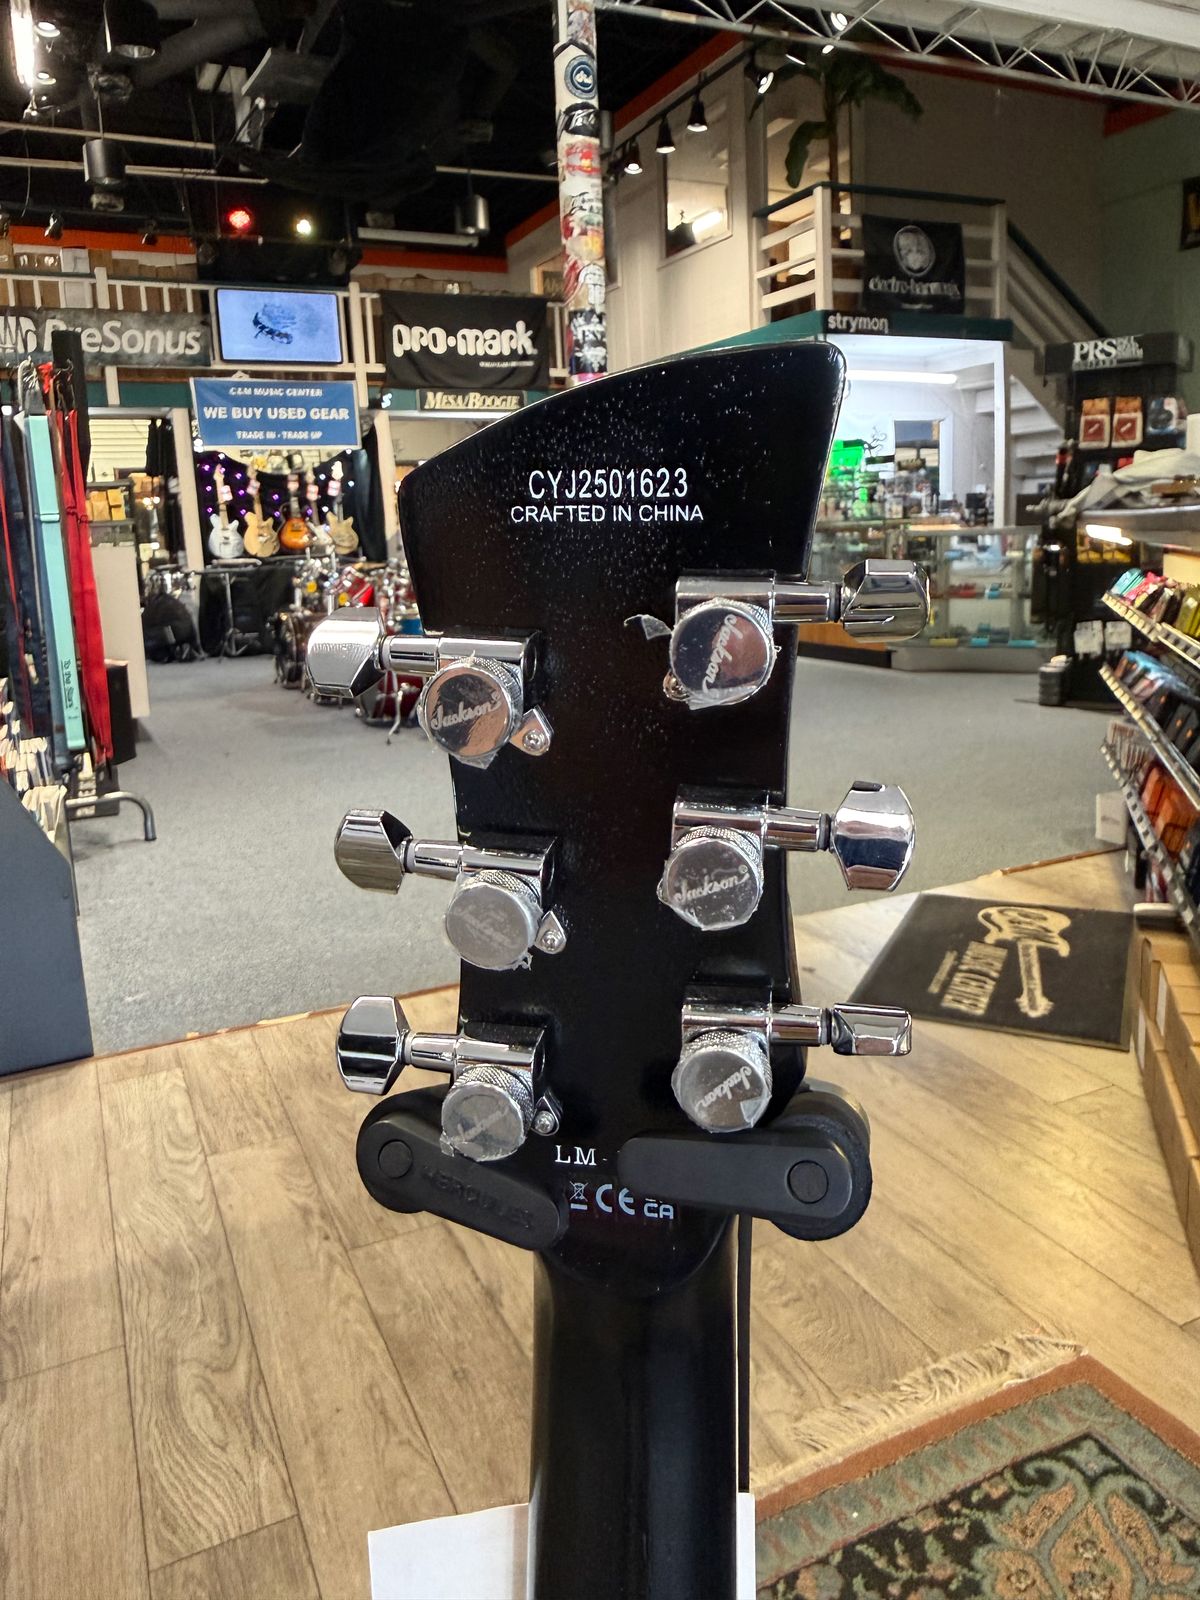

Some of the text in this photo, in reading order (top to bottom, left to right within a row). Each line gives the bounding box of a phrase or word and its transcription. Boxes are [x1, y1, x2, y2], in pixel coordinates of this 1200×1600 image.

[43, 318, 201, 355] PeSonus
[828, 312, 889, 334] strymon
[1073, 337, 1118, 361] PRS
[254, 388, 284, 396] MUSIC
[286, 388, 323, 397] CENTER
[203, 406, 350, 421] WE BUY USED GEAR
[236, 430, 264, 440] TRADE
[282, 431, 309, 440] TRADE
[529, 467, 689, 499] CYJ2501623
[510, 504, 704, 523] CRAFTED IN CHINA
[694, 613, 739, 694] Jackson
[430, 693, 502, 731] Jackson
[674, 873, 750, 904] Jackson
[695, 1065, 753, 1113] Jackson
[595, 1183, 636, 1216] CE
